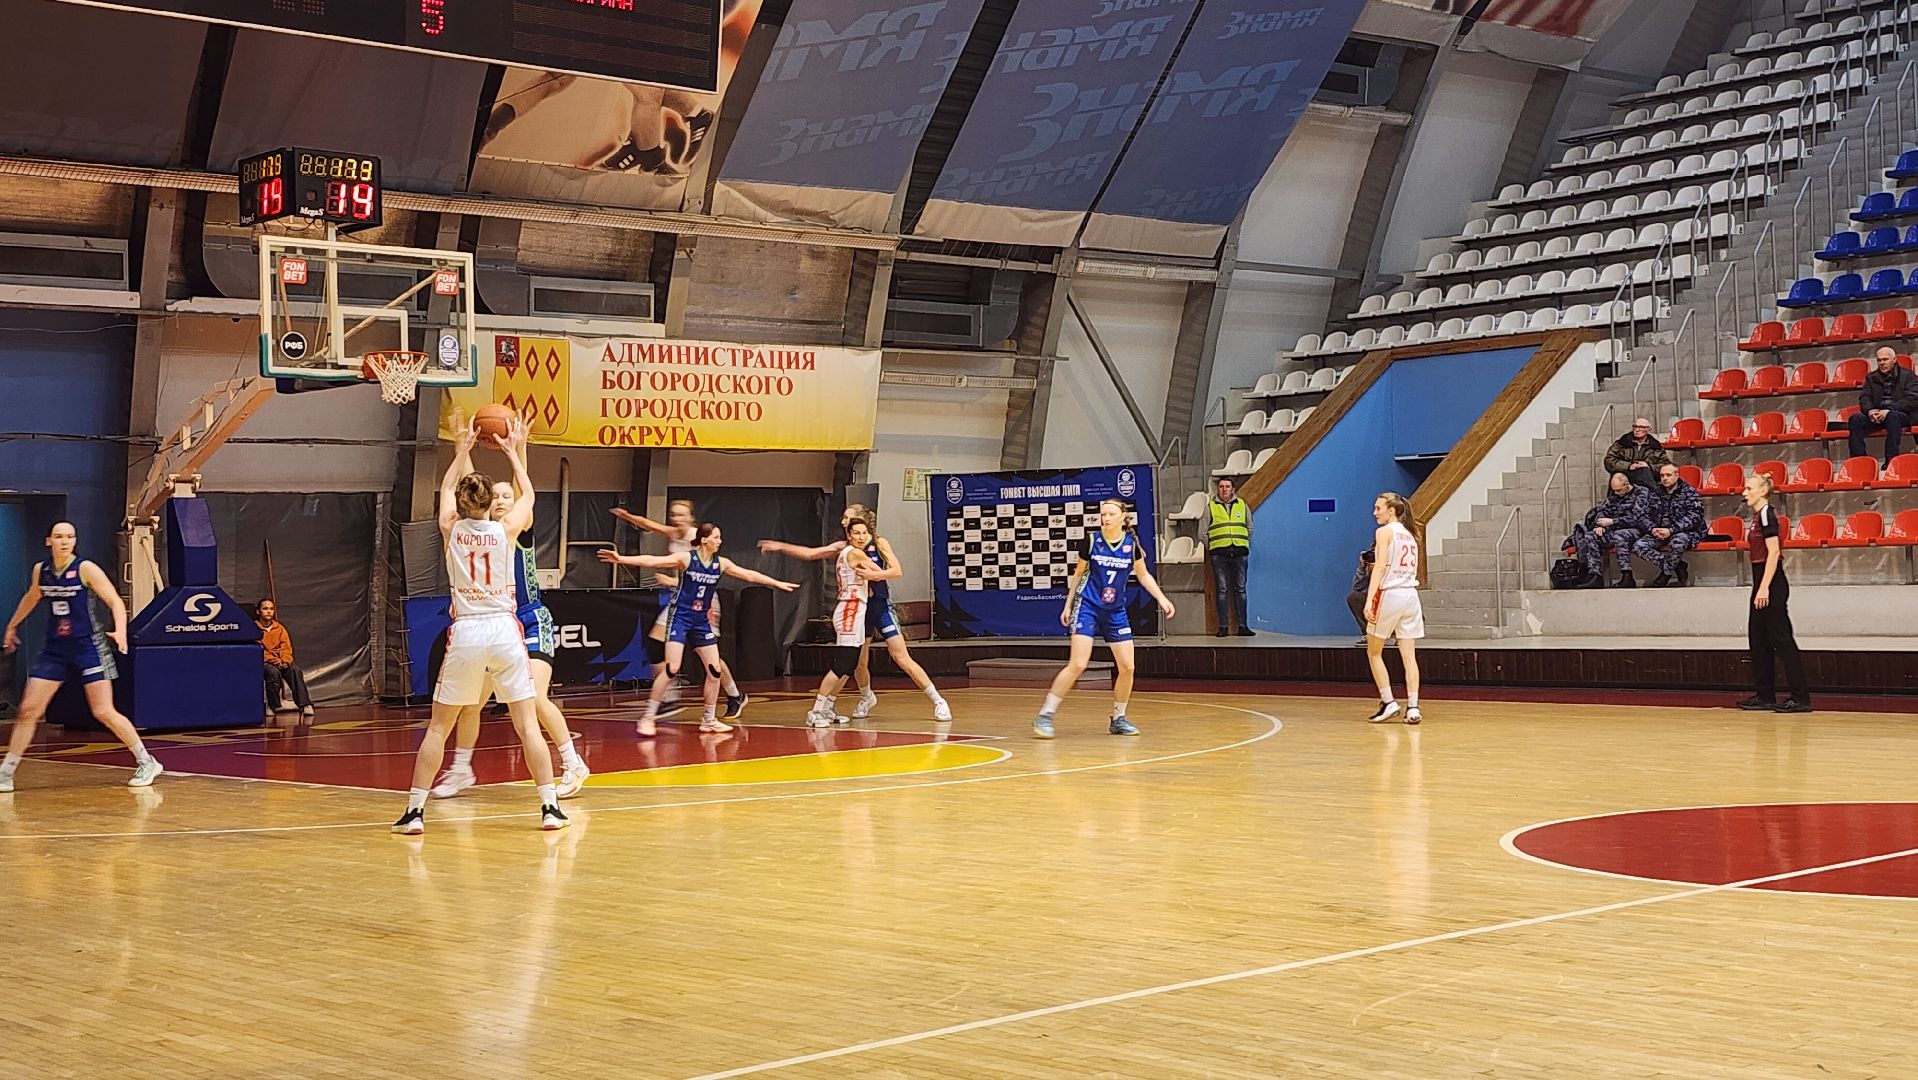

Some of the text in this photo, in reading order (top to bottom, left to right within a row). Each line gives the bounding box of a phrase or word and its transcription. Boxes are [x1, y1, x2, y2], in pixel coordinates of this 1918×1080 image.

[421, 0, 445, 35] 5
[339, 183, 373, 217] 14
[283, 262, 305, 271] FON
[283, 271, 305, 281] BET
[436, 274, 457, 283] FON
[436, 282, 457, 292] BET
[285, 341, 304, 350] РФБ
[601, 342, 816, 374] АДМИНИСТРАЦИЯ
[601, 369, 794, 398] БОГОРОДСКОГО
[600, 397, 763, 424] ГОРОДСКОГО
[598, 424, 699, 446] ОКРУГА
[1027, 485, 1061, 498] ВЫСШАЯ
[1062, 484, 1081, 497] ЛИГА
[456, 533, 498, 547] КОРОЛЬ
[1399, 544, 1416, 567] 25
[465, 550, 492, 586] 11
[1106, 570, 1118, 585] 7
[696, 585, 707, 598] 3
[207, 623, 239, 633] Sports
